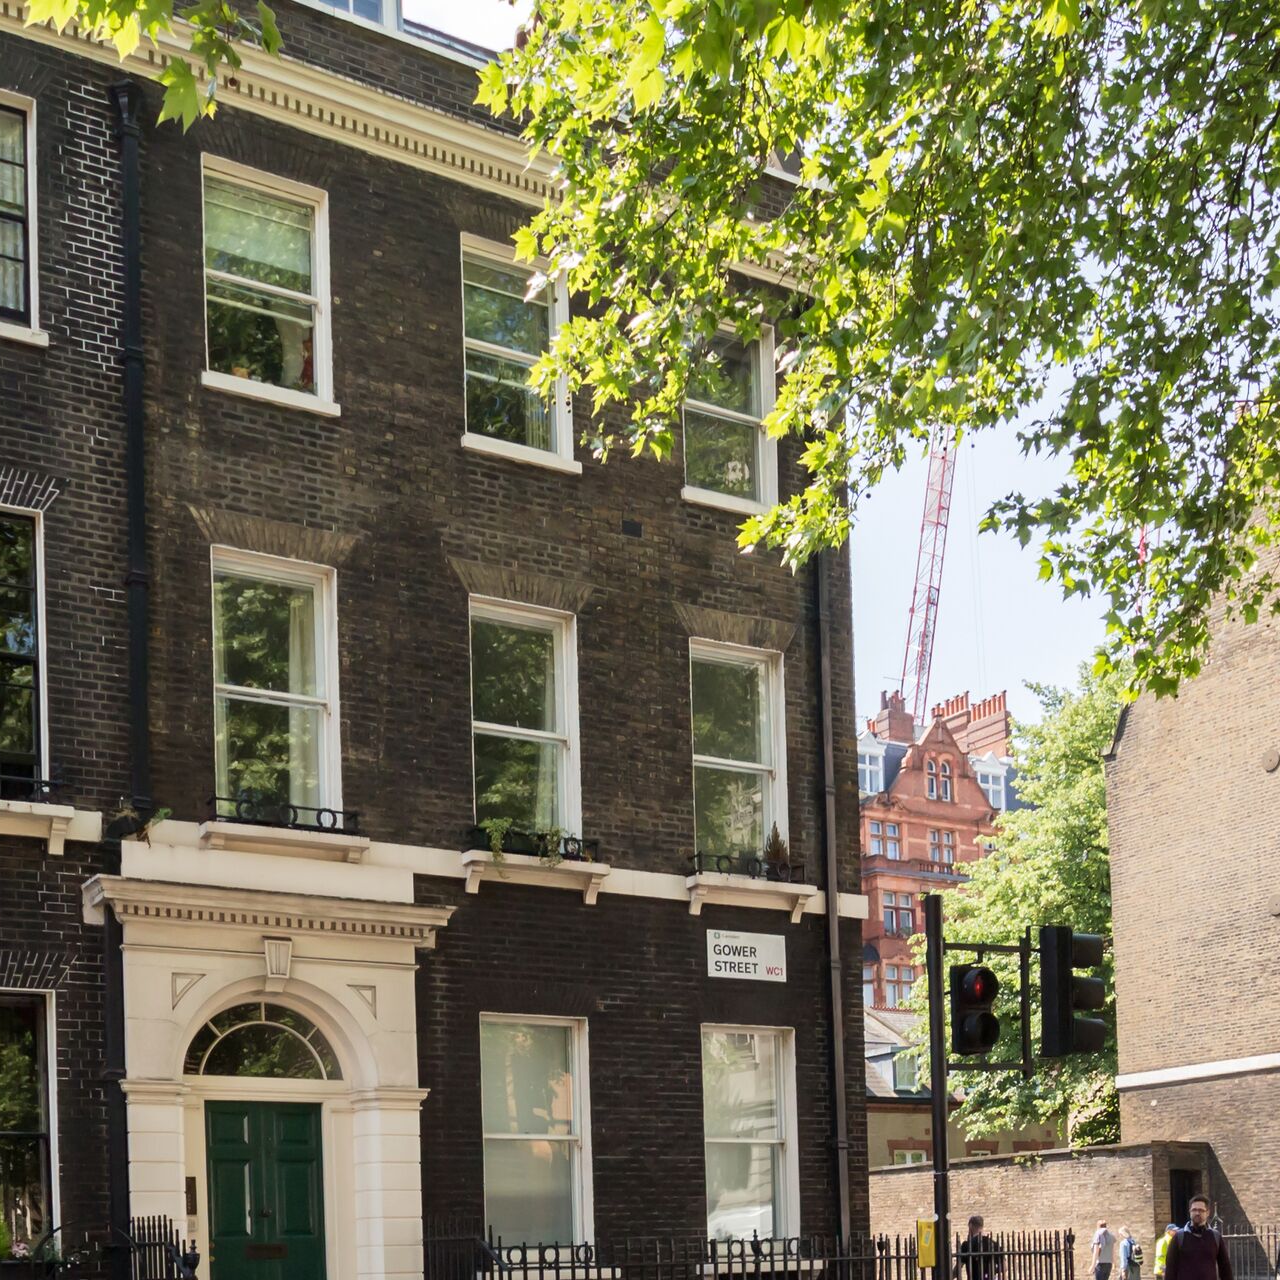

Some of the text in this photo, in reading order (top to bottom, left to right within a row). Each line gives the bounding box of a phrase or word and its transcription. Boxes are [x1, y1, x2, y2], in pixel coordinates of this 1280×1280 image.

[713, 944, 757, 958] GOWER
[714, 960, 783, 976] STREET WC1
